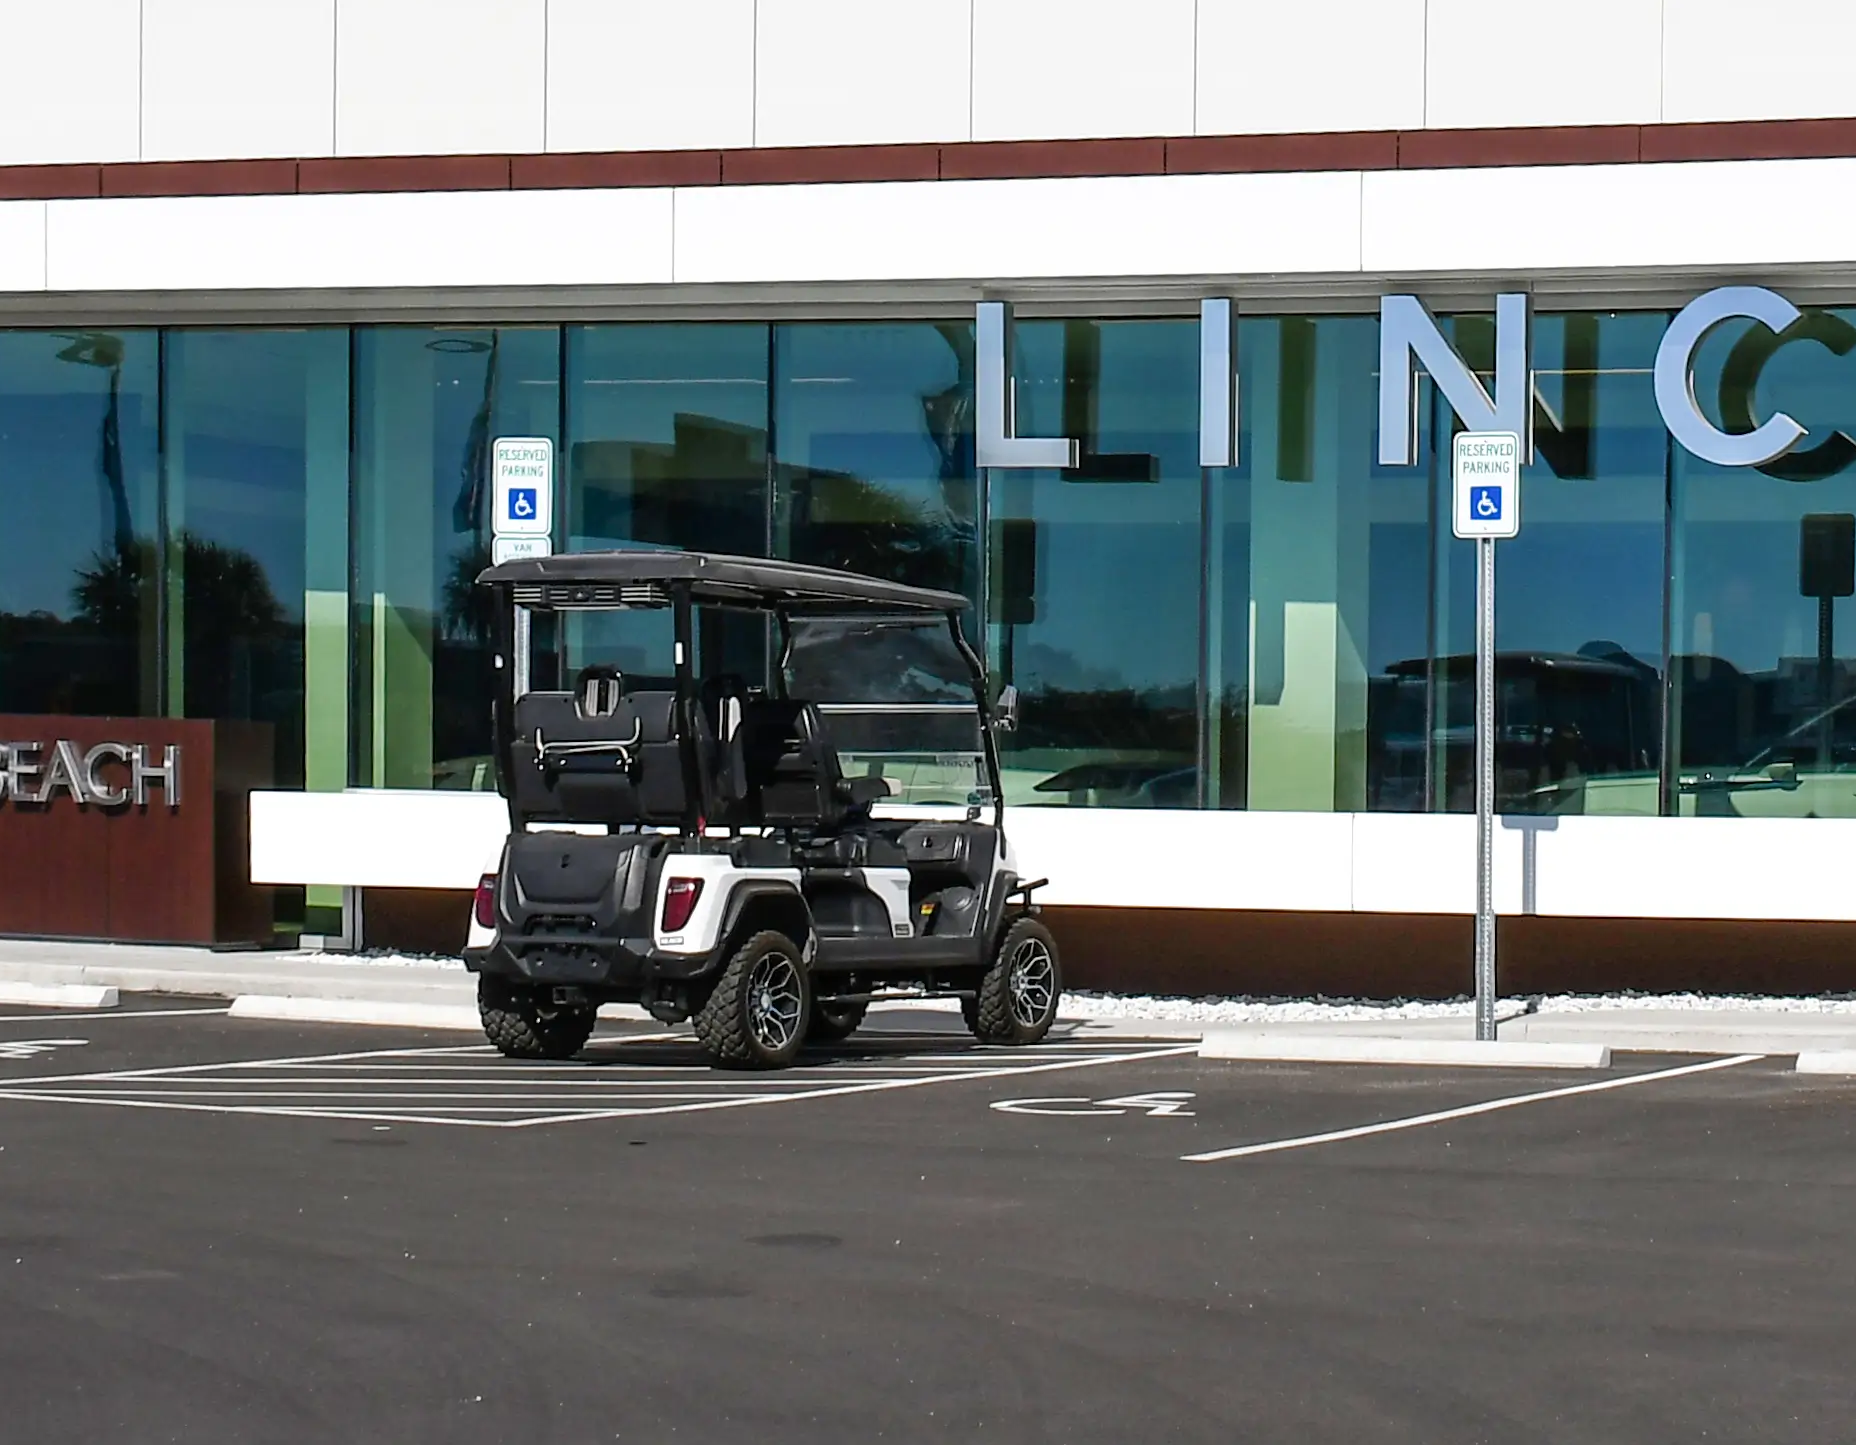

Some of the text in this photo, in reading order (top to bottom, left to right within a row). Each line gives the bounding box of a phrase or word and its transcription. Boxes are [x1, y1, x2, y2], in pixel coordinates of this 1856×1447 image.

[498, 448, 548, 462] RESERVED
[1459, 443, 1514, 457] RESERVED
[501, 464, 544, 478] PARKING
[1463, 461, 1510, 474] PARKING
